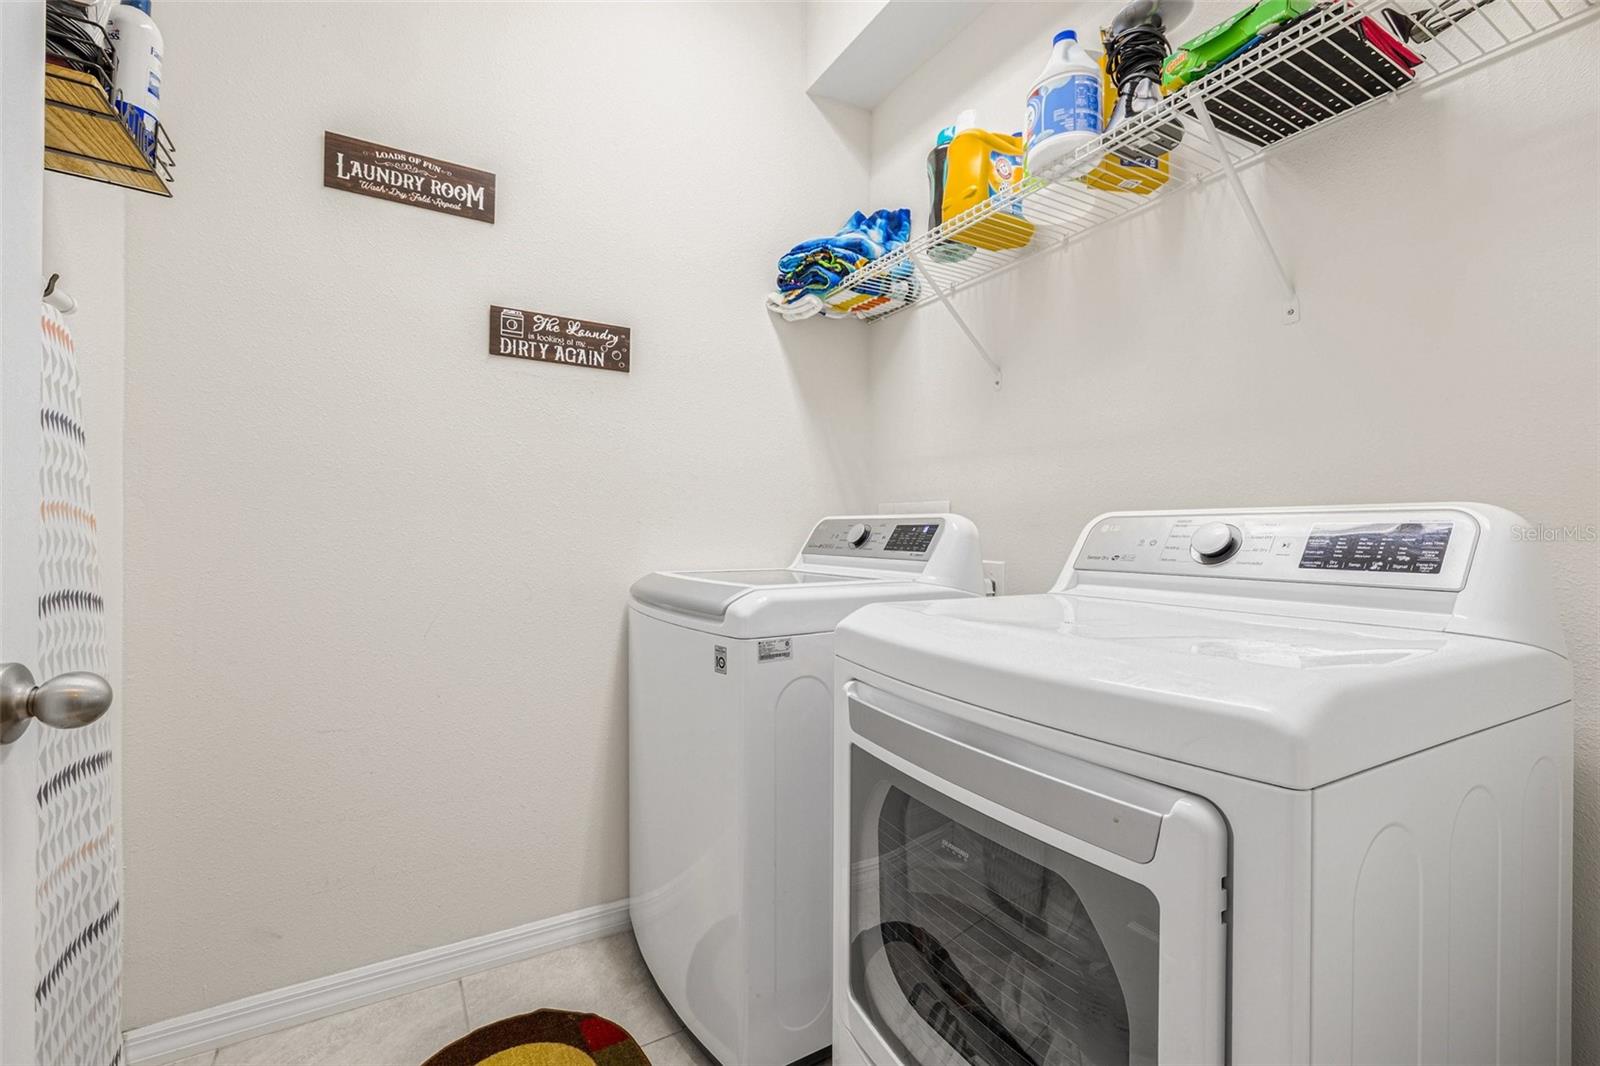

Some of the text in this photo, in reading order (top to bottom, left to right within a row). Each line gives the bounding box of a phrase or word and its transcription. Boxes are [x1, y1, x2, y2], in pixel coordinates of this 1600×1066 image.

[375, 151, 442, 173] LOADS OF FUN
[336, 152, 485, 211] LAUNDRY ROOM
[360, 180, 462, 209] Wash Dry Fold Repeat
[533, 314, 619, 348] The Laundry
[536, 333, 565, 346] looking
[500, 337, 605, 367] DIRTY AGAIN
